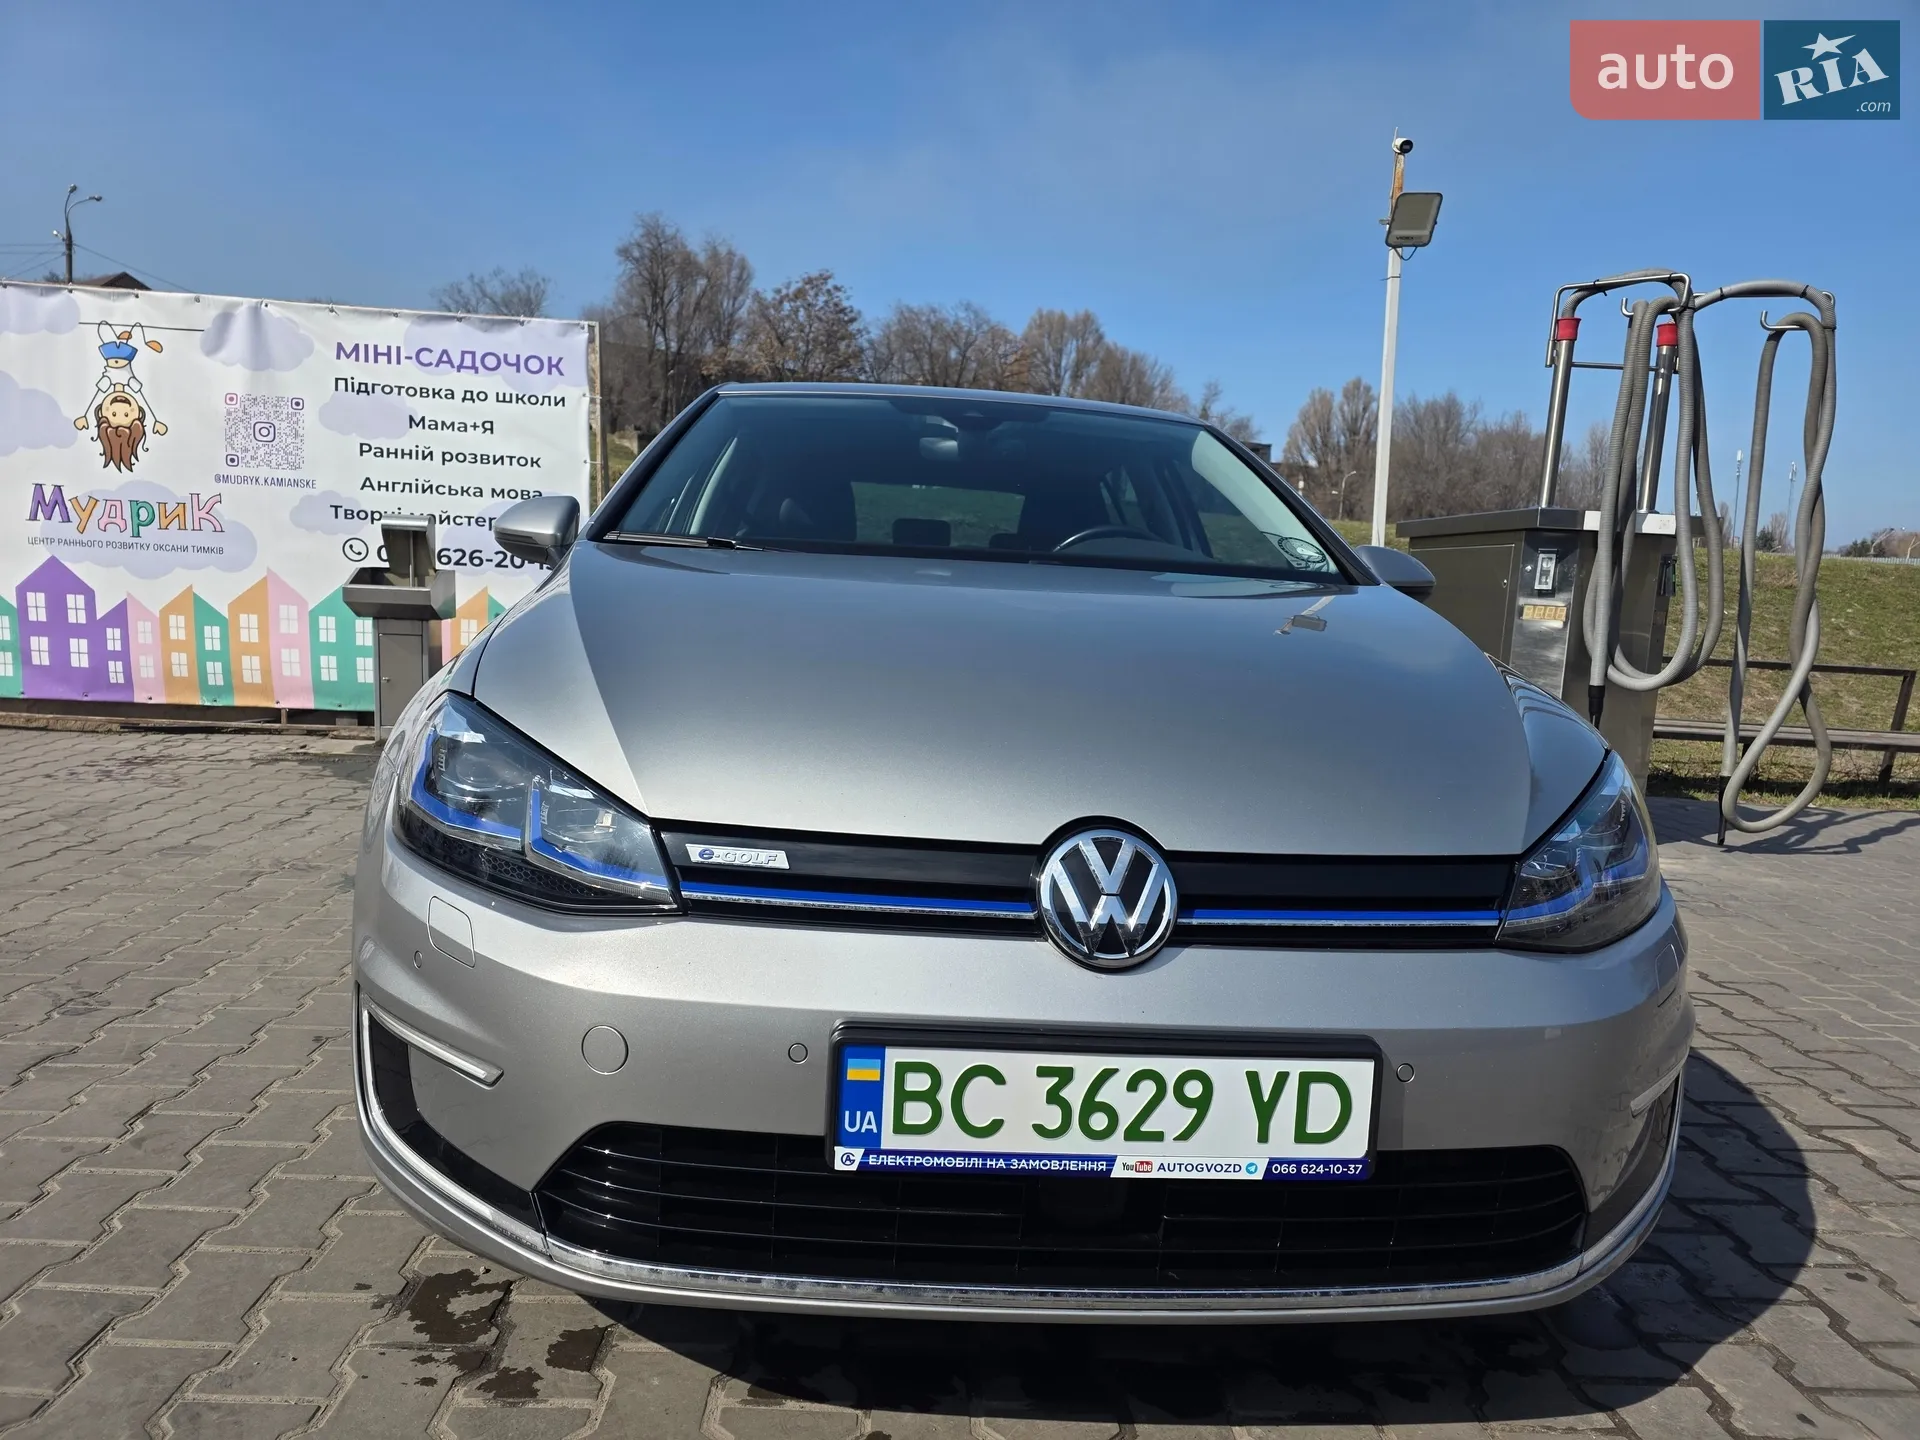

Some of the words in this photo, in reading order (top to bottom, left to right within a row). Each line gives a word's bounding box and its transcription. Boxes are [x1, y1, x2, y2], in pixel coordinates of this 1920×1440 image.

[335, 341, 565, 377] МІНІ-САДОЧОК
[334, 377, 455, 400] Підготовка
[461, 389, 488, 404] до
[495, 391, 566, 408] школи
[408, 414, 494, 435] Мама+Я
[359, 442, 434, 462] Ранній
[441, 450, 542, 469] розвиток
[214, 473, 317, 490] @MUDRYK.KAMIANSKE
[359, 476, 484, 499] Англійська
[329, 504, 402, 525] Твор
[27, 536, 56, 546] ЦЕНТР
[57, 538, 104, 549] РАННЬОГО
[105, 540, 150, 551] РОЗВИТКУ
[152, 543, 189, 553] ОКСАНИ
[191, 545, 224, 555] ТИМКІВ
[698, 848, 778, 865] e-GOLF
[892, 1061, 1006, 1139] BC
[1031, 1065, 1213, 1142] 3629
[1245, 1070, 1352, 1144] YD
[844, 1110, 878, 1133] UA
[868, 1155, 982, 1169] ЕЛЕКТРОМОБІЛІ
[986, 1159, 1006, 1169] НА
[1010, 1158, 1107, 1172] ЗАМОВЛЕННЯ
[1156, 1162, 1242, 1173] AUTOGVOZD
[1271, 1163, 1297, 1174] 066
[1300, 1163, 1363, 1175] 624-10-37
